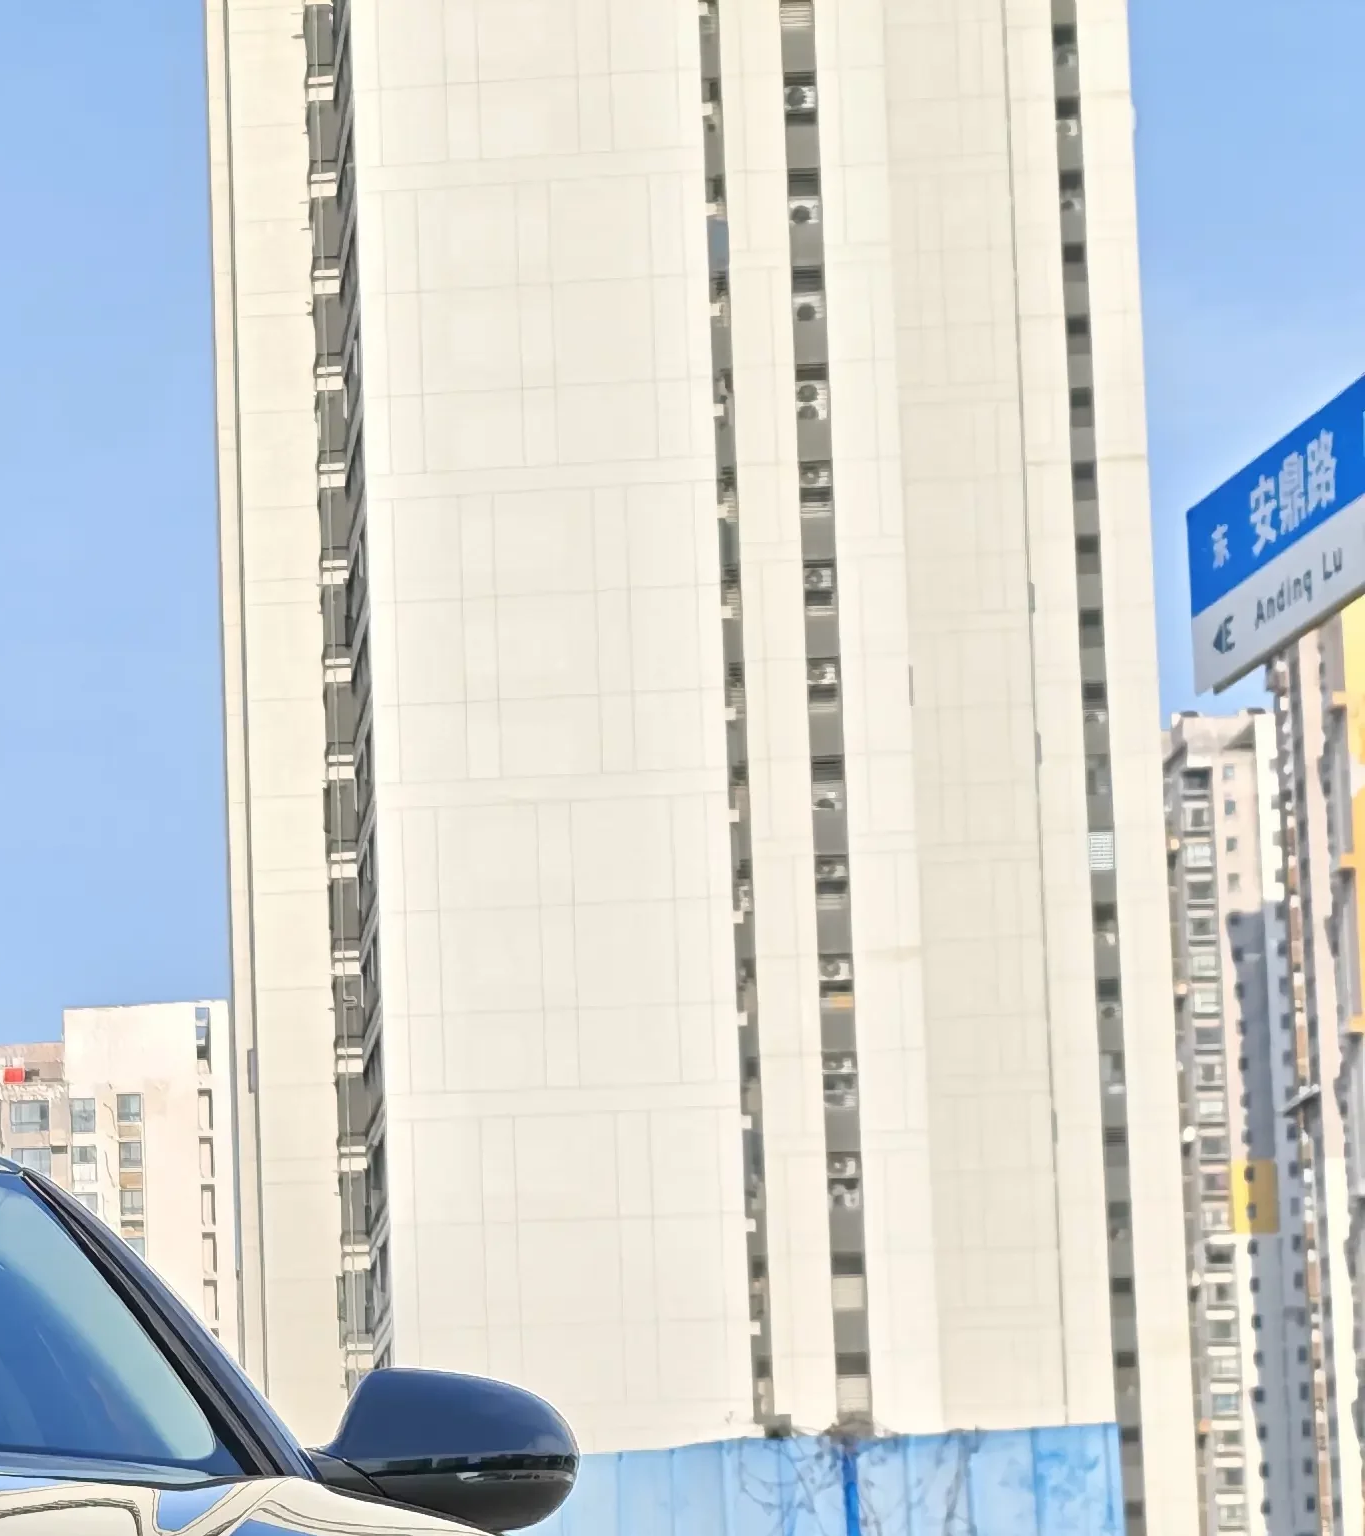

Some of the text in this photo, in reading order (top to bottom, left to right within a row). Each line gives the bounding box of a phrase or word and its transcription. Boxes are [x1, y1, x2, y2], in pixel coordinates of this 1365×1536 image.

[1249, 429, 1337, 557] 安鼎路
[1255, 568, 1313, 630] Anding
[1322, 547, 1343, 581] Lu
